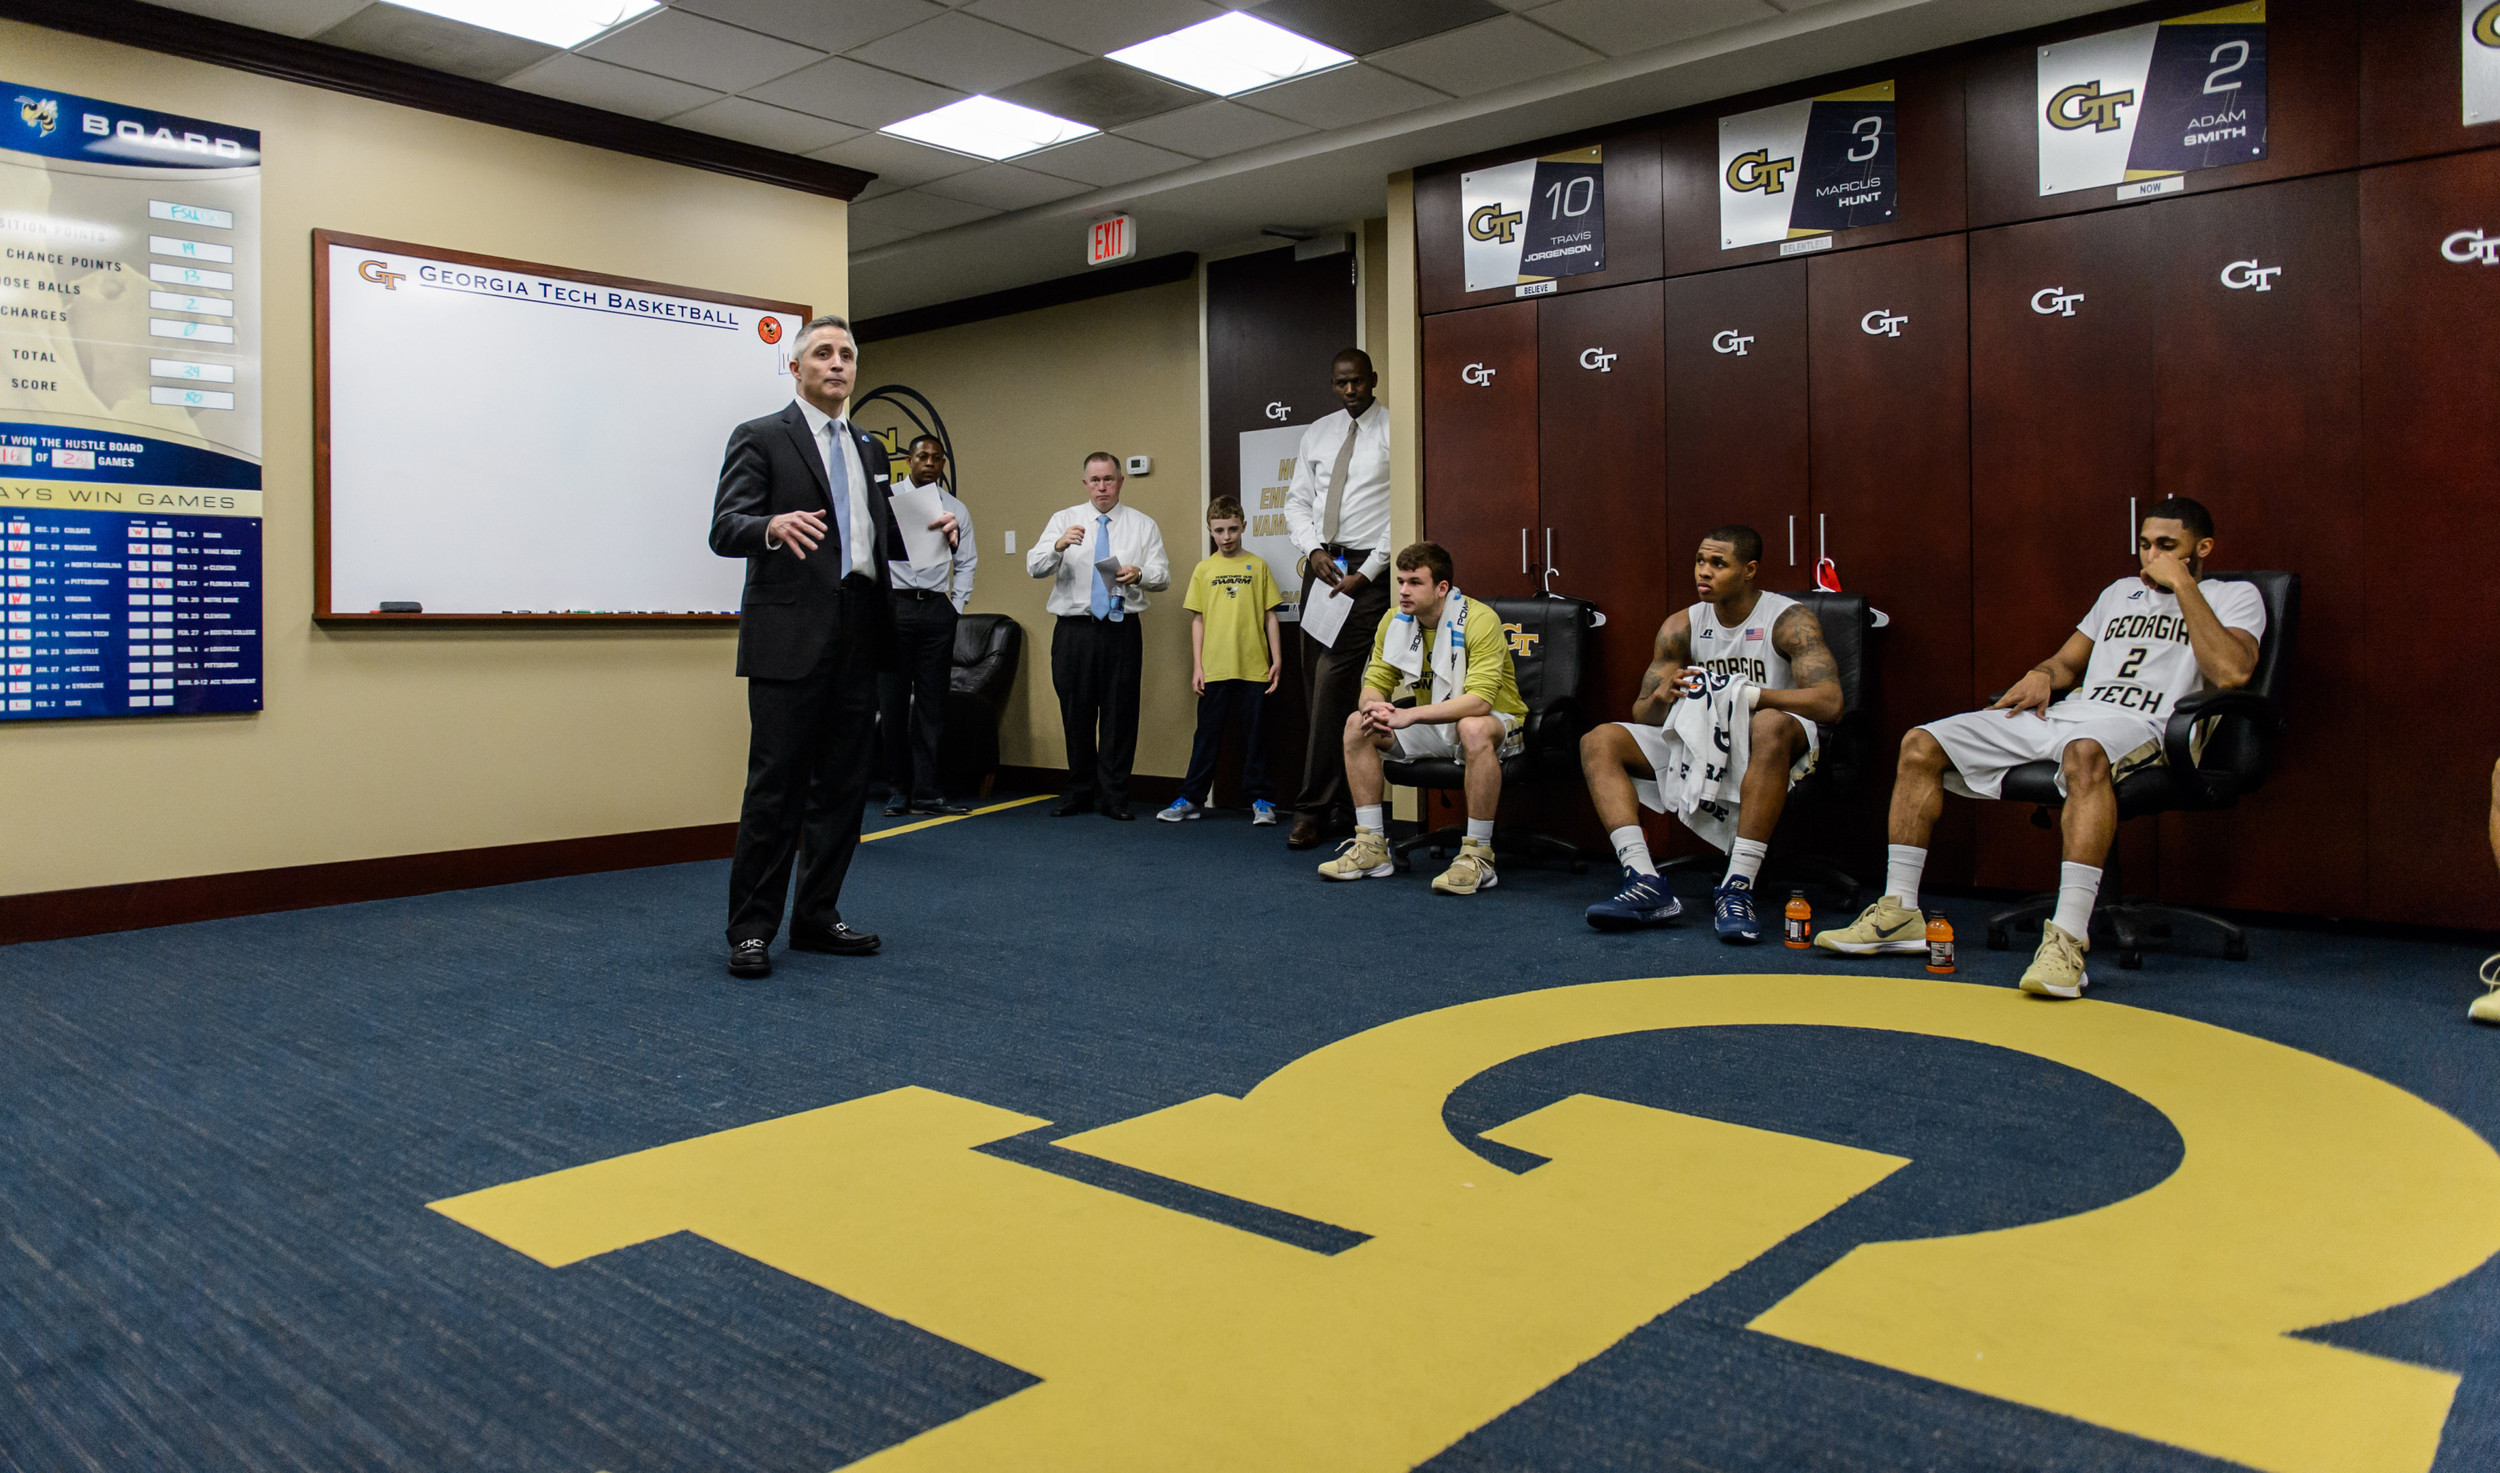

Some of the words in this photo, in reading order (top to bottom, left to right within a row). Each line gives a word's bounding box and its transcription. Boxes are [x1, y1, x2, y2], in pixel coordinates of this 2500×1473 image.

[2203, 40, 2249, 95] 2
[2046, 79, 2134, 134] GT
[2187, 109, 2246, 130] ADAM
[83, 113, 241, 159] BOARD
[1847, 116, 1882, 163] 3
[2184, 126, 2246, 146] SMITH
[1726, 148, 1794, 195] GT
[1816, 177, 1881, 197] MARCUS
[2140, 183, 2161, 195] NOW
[1546, 176, 1594, 220] 10
[1838, 191, 1882, 207] HUNT
[1468, 202, 1522, 244] GT
[54, 225, 106, 242] POINTS
[1095, 218, 1124, 260] EXIT
[1550, 231, 1591, 246] TRAVIS
[1525, 244, 1592, 262] JORGENSON
[1783, 239, 1829, 254] RELENTLESS
[7, 248, 64, 265] CHANCE
[72, 256, 122, 272] POINTS
[0, 276, 30, 290] OSE
[38, 281, 81, 295] BALLS
[358, 260, 406, 290] GT
[419, 265, 528, 295] GEORGIA
[538, 282, 597, 305] TECH
[608, 292, 739, 325] BASKETBALL
[1524, 284, 1548, 295] BELIEVE
[1, 306, 67, 322] CHARGES
[12, 349, 56, 363] TOTAL
[12, 378, 57, 392] SCORE
[11, 435, 37, 447] WON
[41, 437, 61, 448] THE
[65, 439, 106, 450] HUSTLE
[109, 441, 143, 453] BOARD
[35, 452, 48, 462] OF
[98, 456, 134, 467] GAMES
[68, 490, 122, 504] WIN
[138, 493, 235, 509] GAMES
[1212, 578, 1251, 586] SWARM
[2104, 614, 2190, 646] GEORGIA
[2117, 648, 2148, 679] 2
[2089, 685, 2164, 714] TECH
